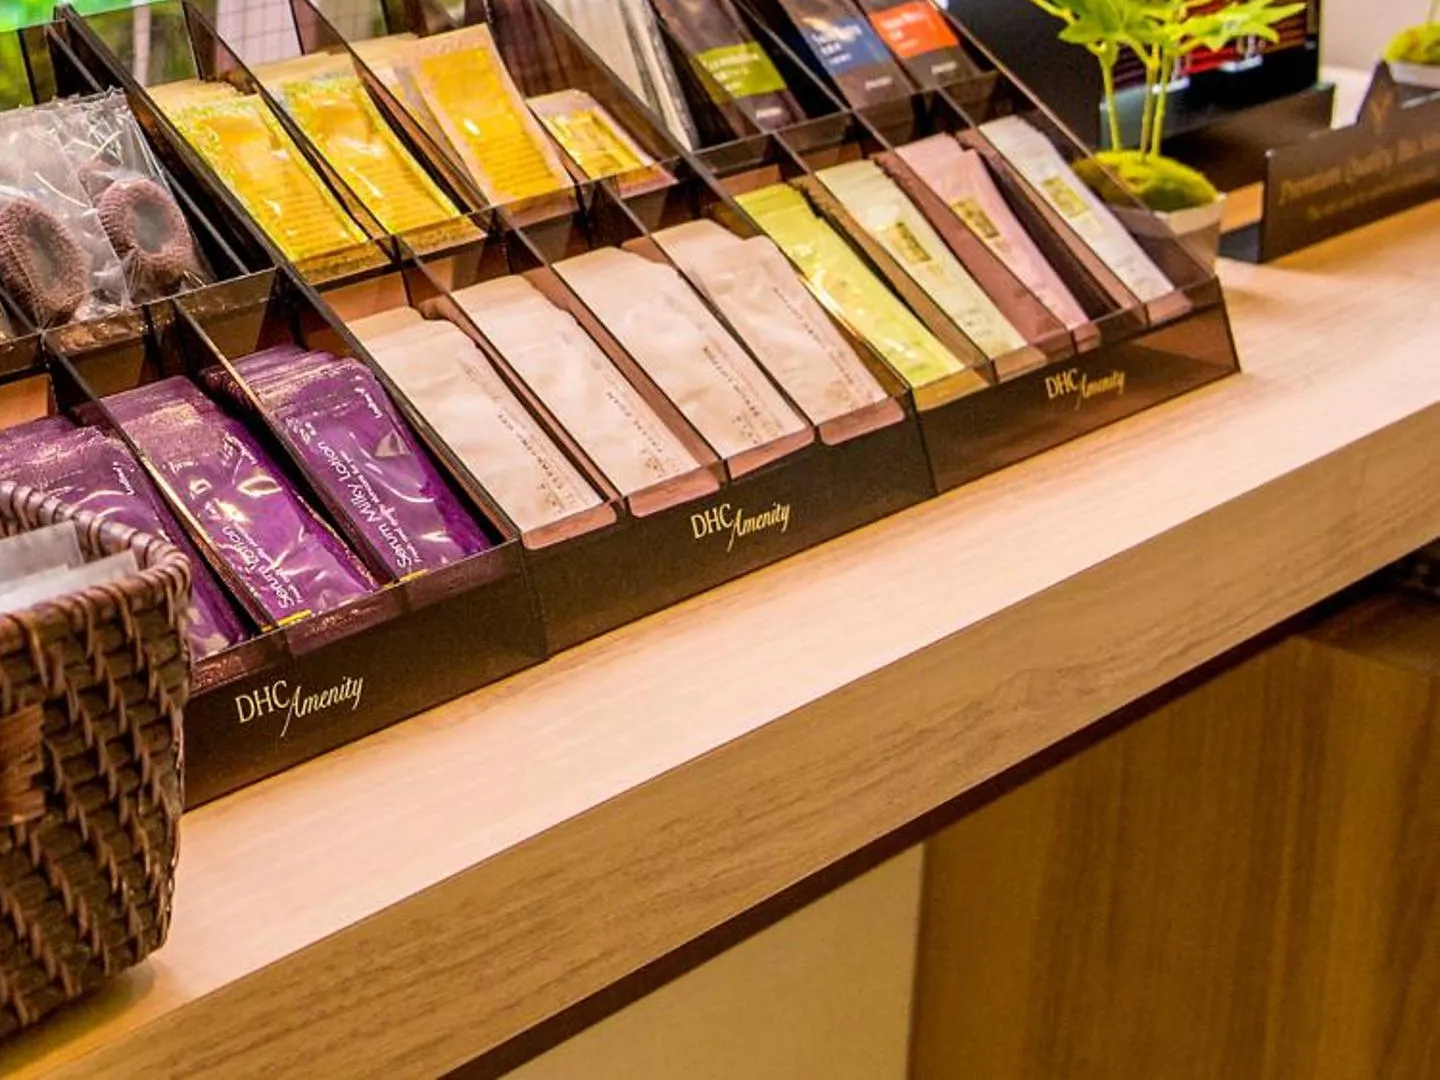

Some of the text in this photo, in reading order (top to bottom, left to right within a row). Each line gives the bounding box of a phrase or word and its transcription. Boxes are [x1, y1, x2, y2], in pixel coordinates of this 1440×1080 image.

[1044, 368, 1079, 399] DHC
[318, 441, 351, 482] Lotion
[347, 484, 382, 522] Milky
[379, 523, 412, 569] Serum
[690, 501, 791, 553] DHC Amenity
[258, 565, 295, 608] Serum
[234, 676, 364, 738] DHC Amenity
